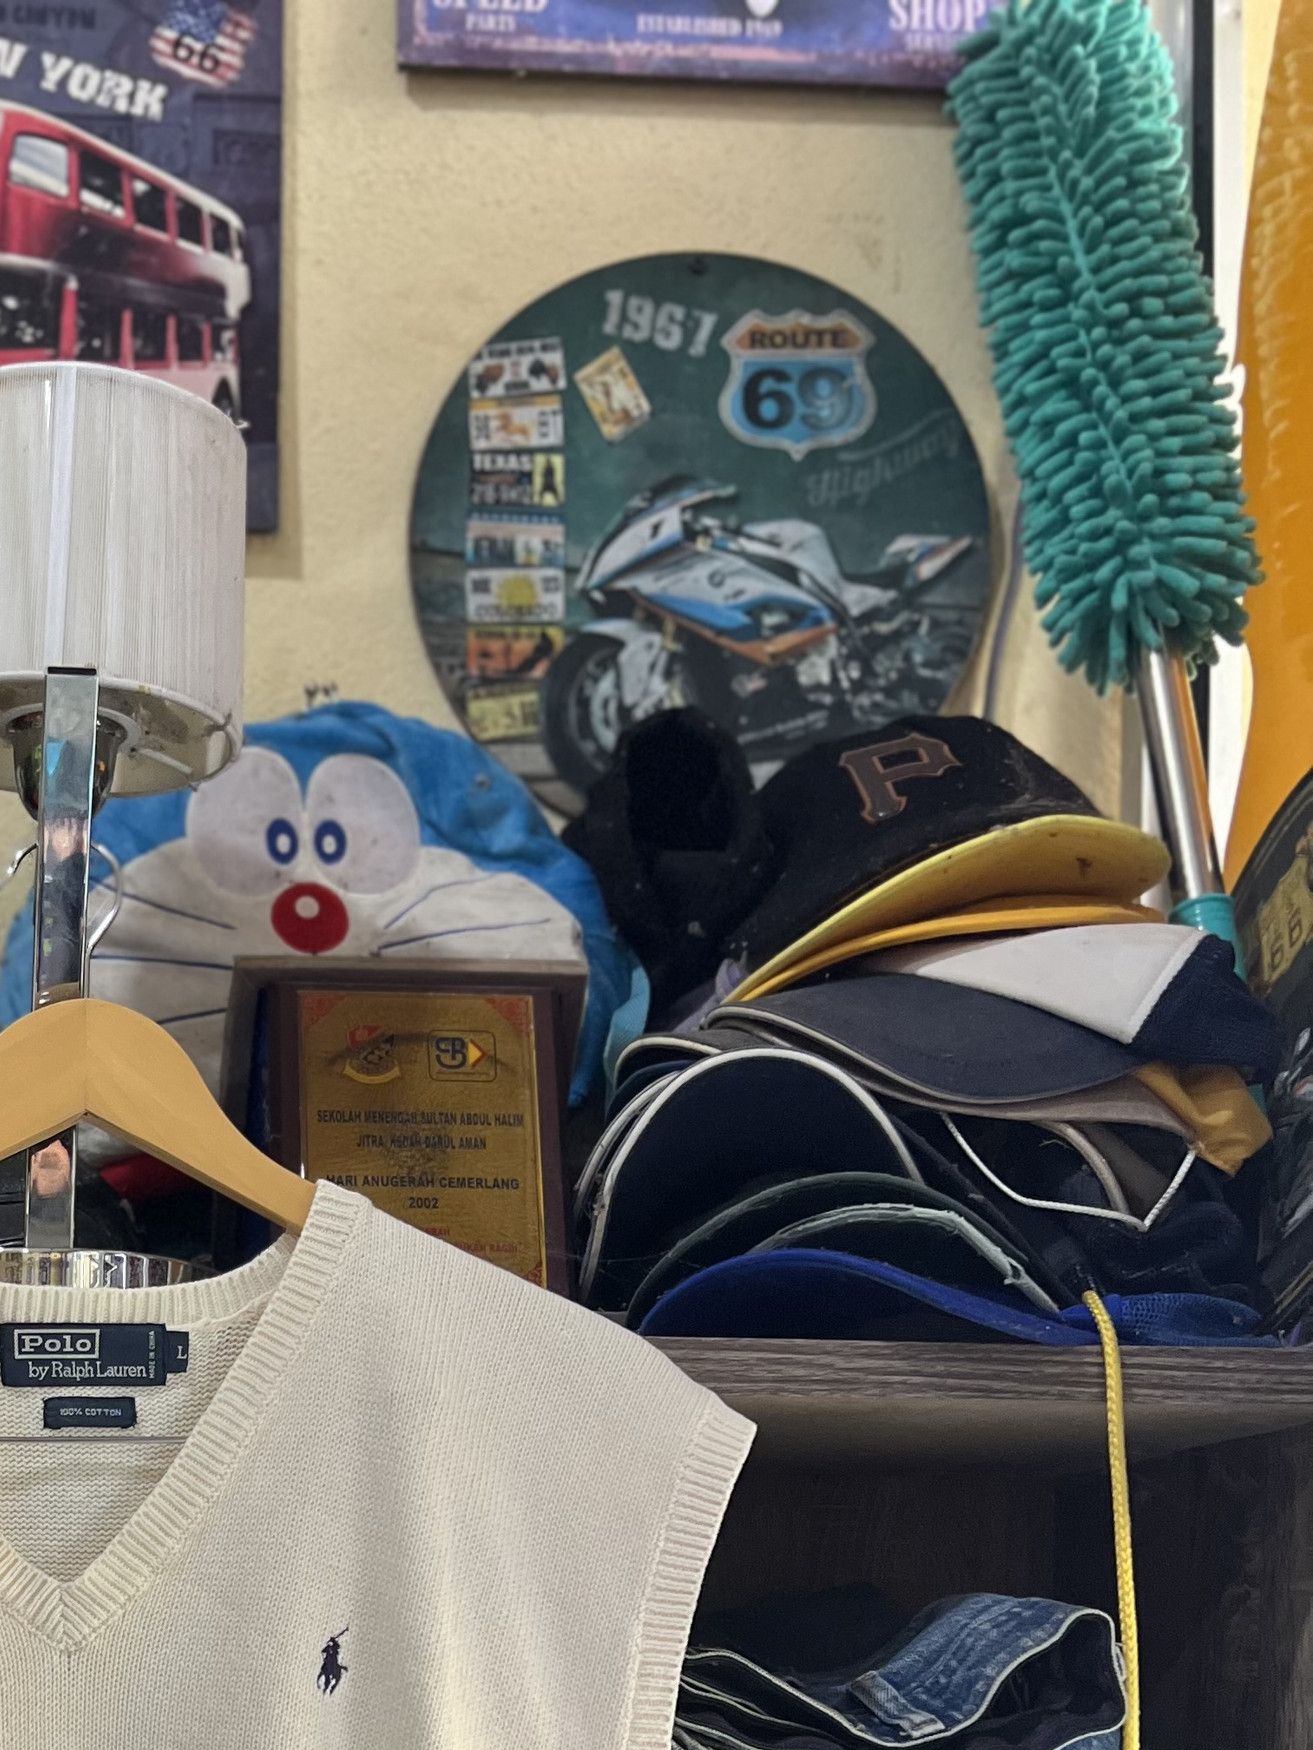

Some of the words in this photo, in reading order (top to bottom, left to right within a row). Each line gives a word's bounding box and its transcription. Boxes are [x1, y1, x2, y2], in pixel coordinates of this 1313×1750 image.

[889, 0, 985, 33] SHOP
[172, 34, 220, 74] 66
[40, 52, 167, 121] YORK
[602, 290, 719, 358] 1967
[749, 327, 848, 350] ROUTE
[839, 732, 963, 825] P
[317, 1110, 361, 1123] SEKOLAH
[459, 1112, 492, 1126] ABDUL
[459, 1137, 487, 1150] AMAN
[362, 1175, 435, 1188] ANUGERAH
[439, 1177, 520, 1190] CEMERLANG
[408, 1197, 439, 1209] 2002
[21, 1335, 92, 1352] Polo
[176, 1345, 188, 1359] L
[28, 1361, 50, 1380] by
[51, 1361, 95, 1381] Ralph
[96, 1361, 147, 1378] Lauren
[59, 1408, 83, 1417] 100%
[85, 1408, 122, 1417] COTTON
